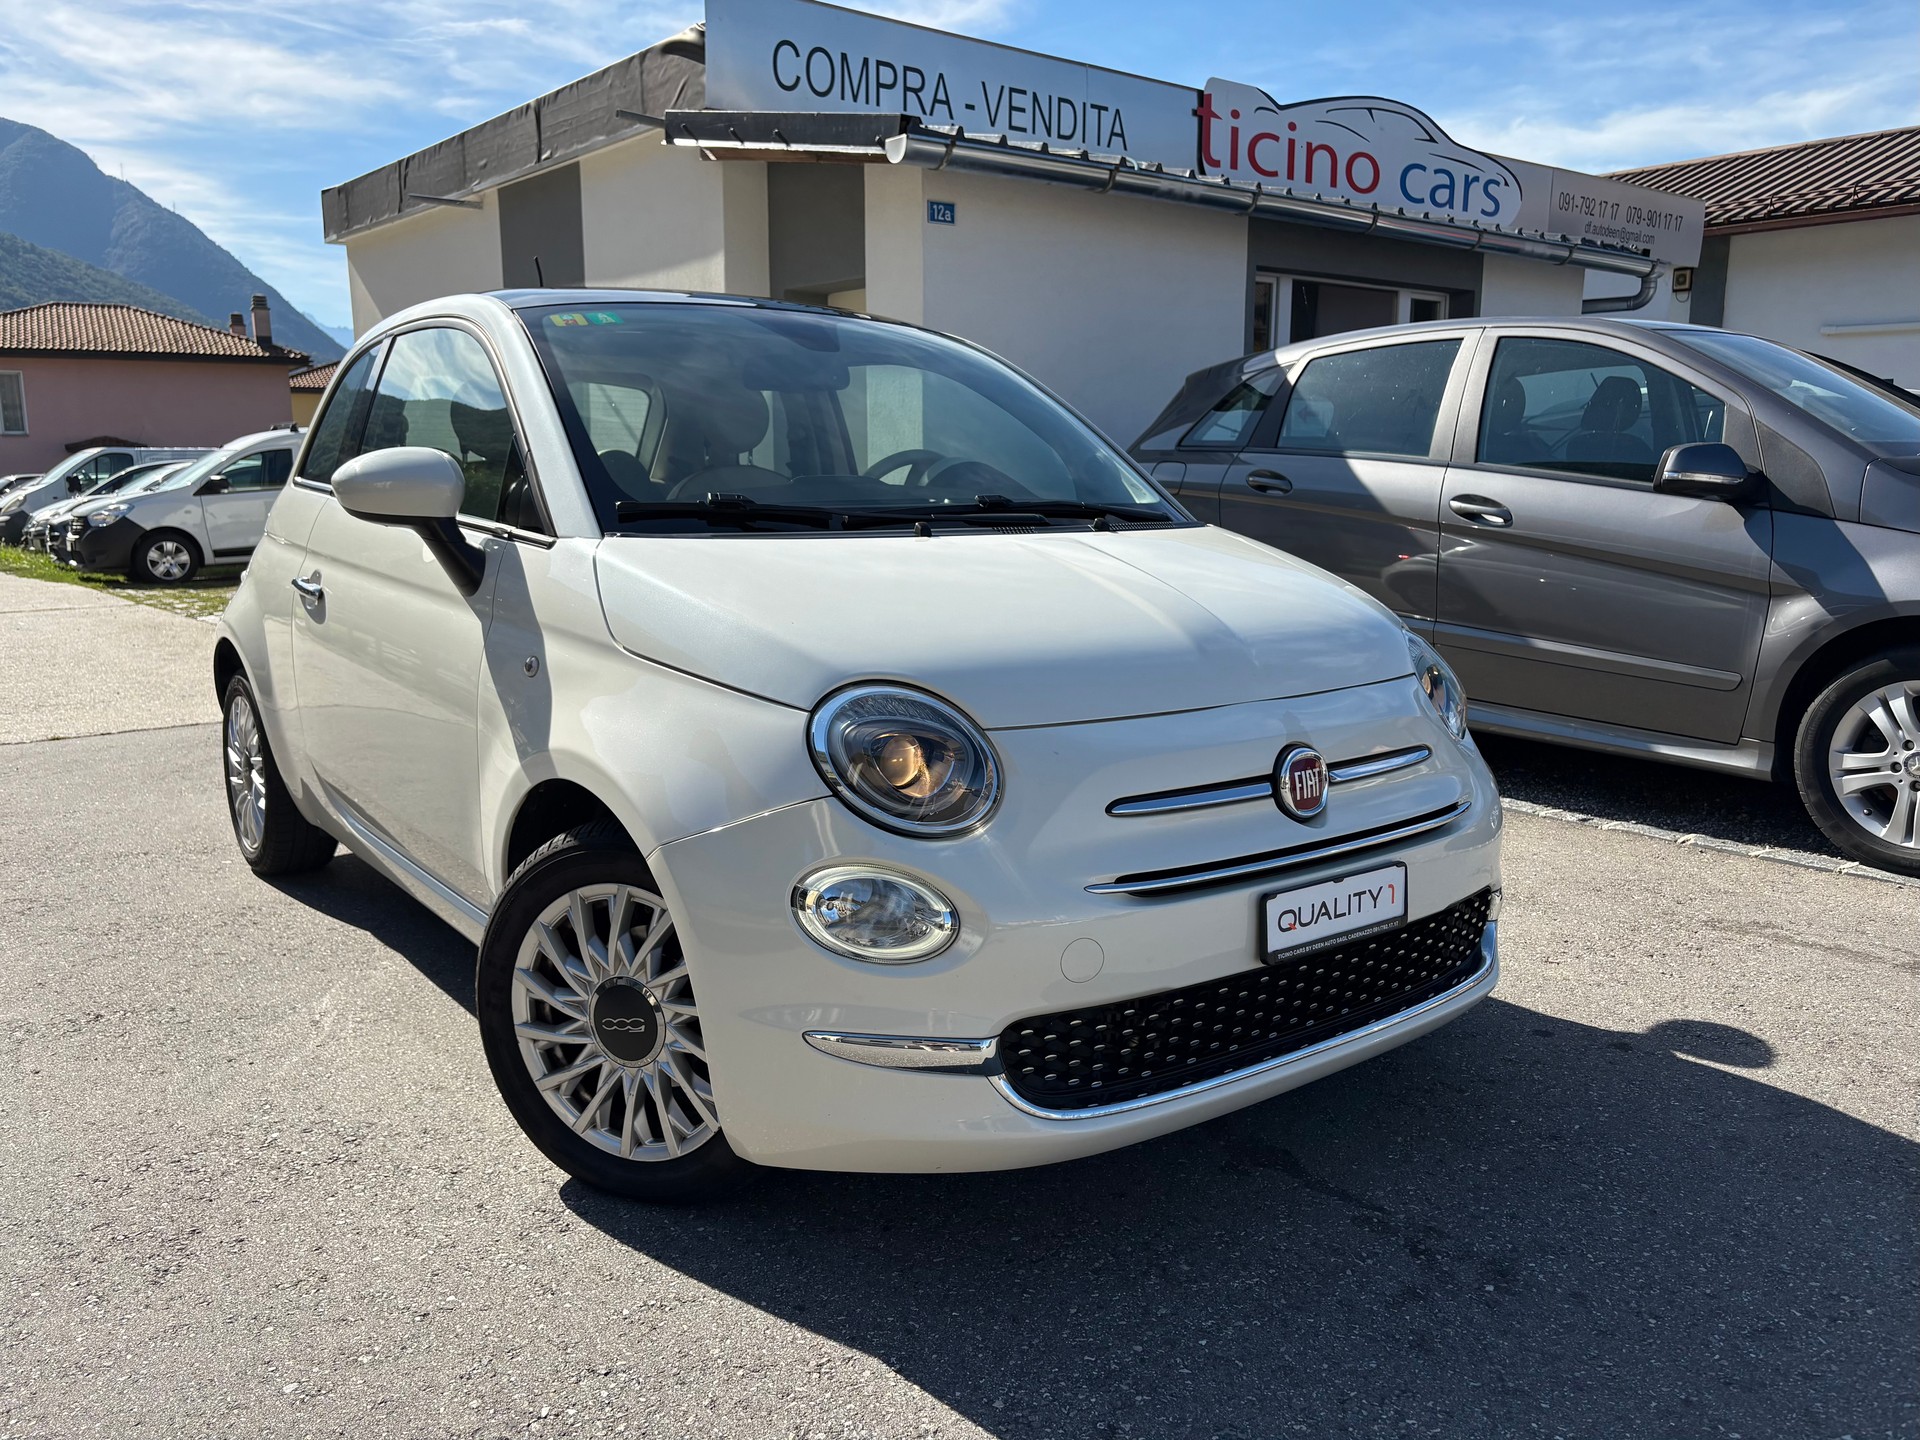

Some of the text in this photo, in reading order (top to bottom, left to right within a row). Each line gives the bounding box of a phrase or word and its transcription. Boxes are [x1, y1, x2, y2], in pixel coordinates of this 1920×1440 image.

[772, 39, 954, 120] COMPRA
[981, 80, 1128, 151] VENDITA
[1197, 93, 1501, 217] ticino cars
[932, 204, 952, 222] 12a
[1558, 191, 1595, 217] 091-792
[1293, 767, 1321, 801] FIAT
